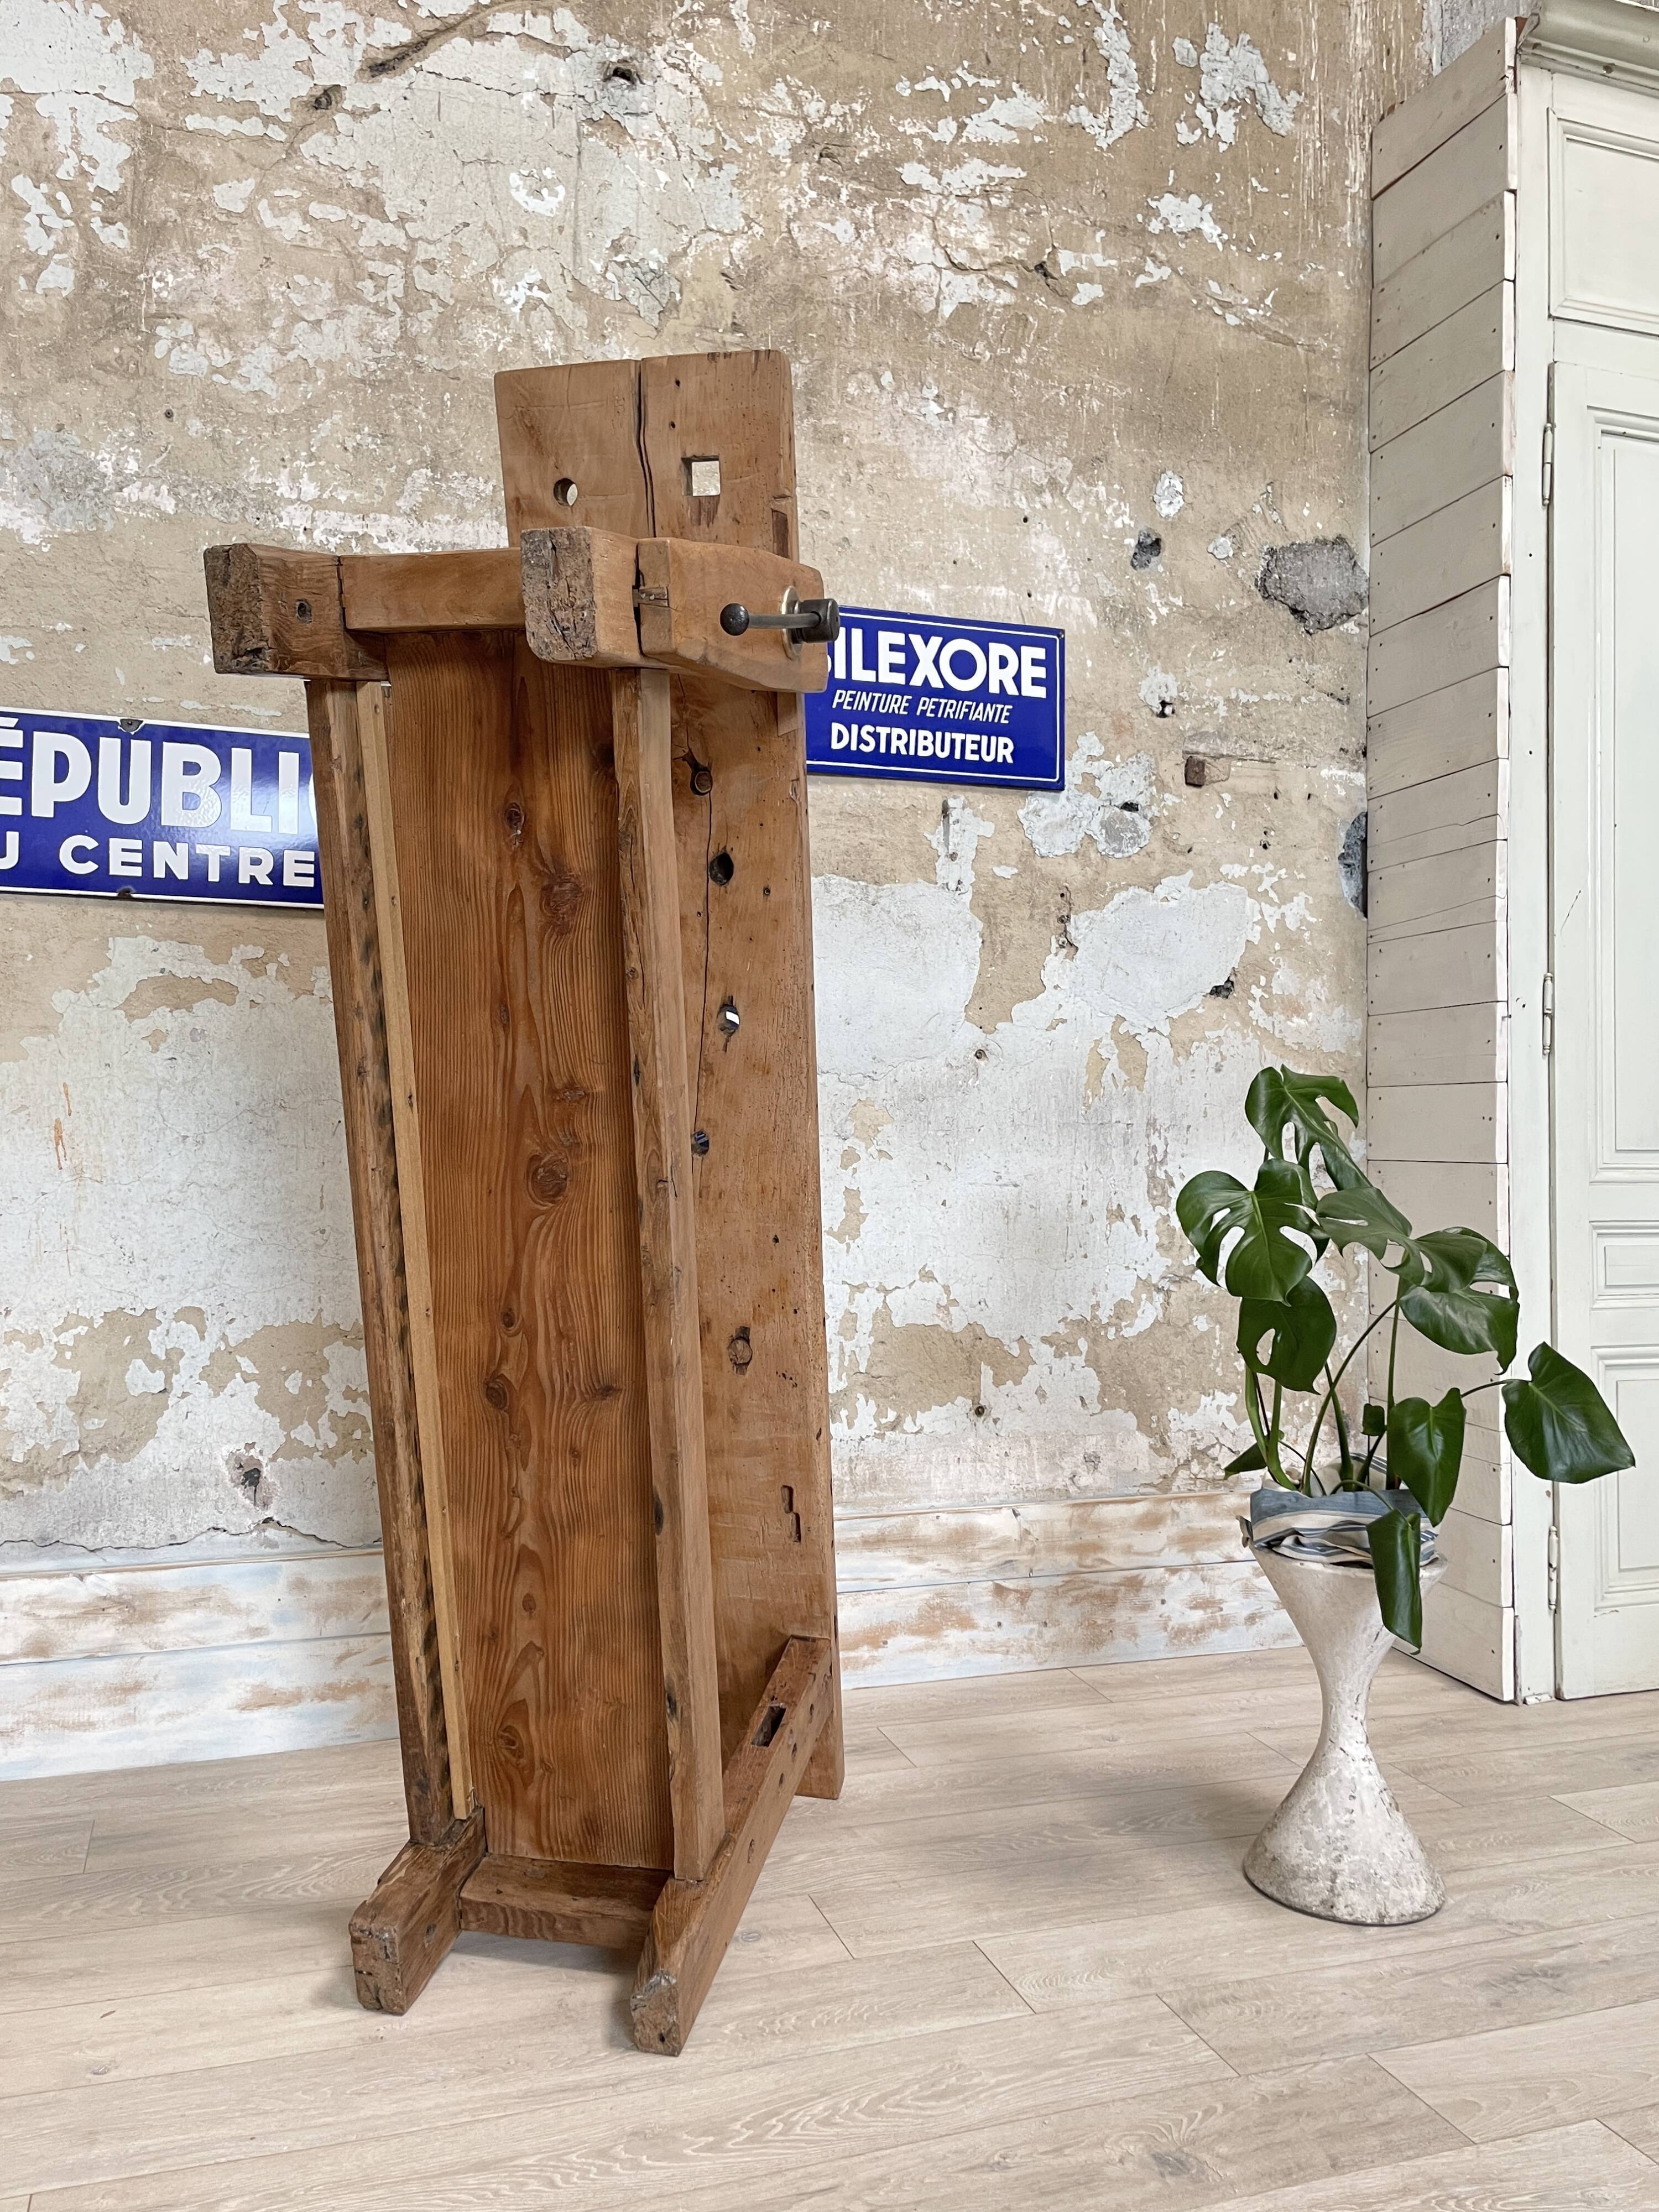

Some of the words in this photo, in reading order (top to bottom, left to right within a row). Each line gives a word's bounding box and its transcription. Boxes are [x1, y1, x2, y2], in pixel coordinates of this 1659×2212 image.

[827, 627, 1047, 698] ILEXORE
[832, 690, 912, 716] PEINTURE
[916, 697, 1013, 724] PETRIFIANTE
[831, 722, 1014, 764] DISTRIBUTEUR
[59, 834, 315, 887] CENTRE
